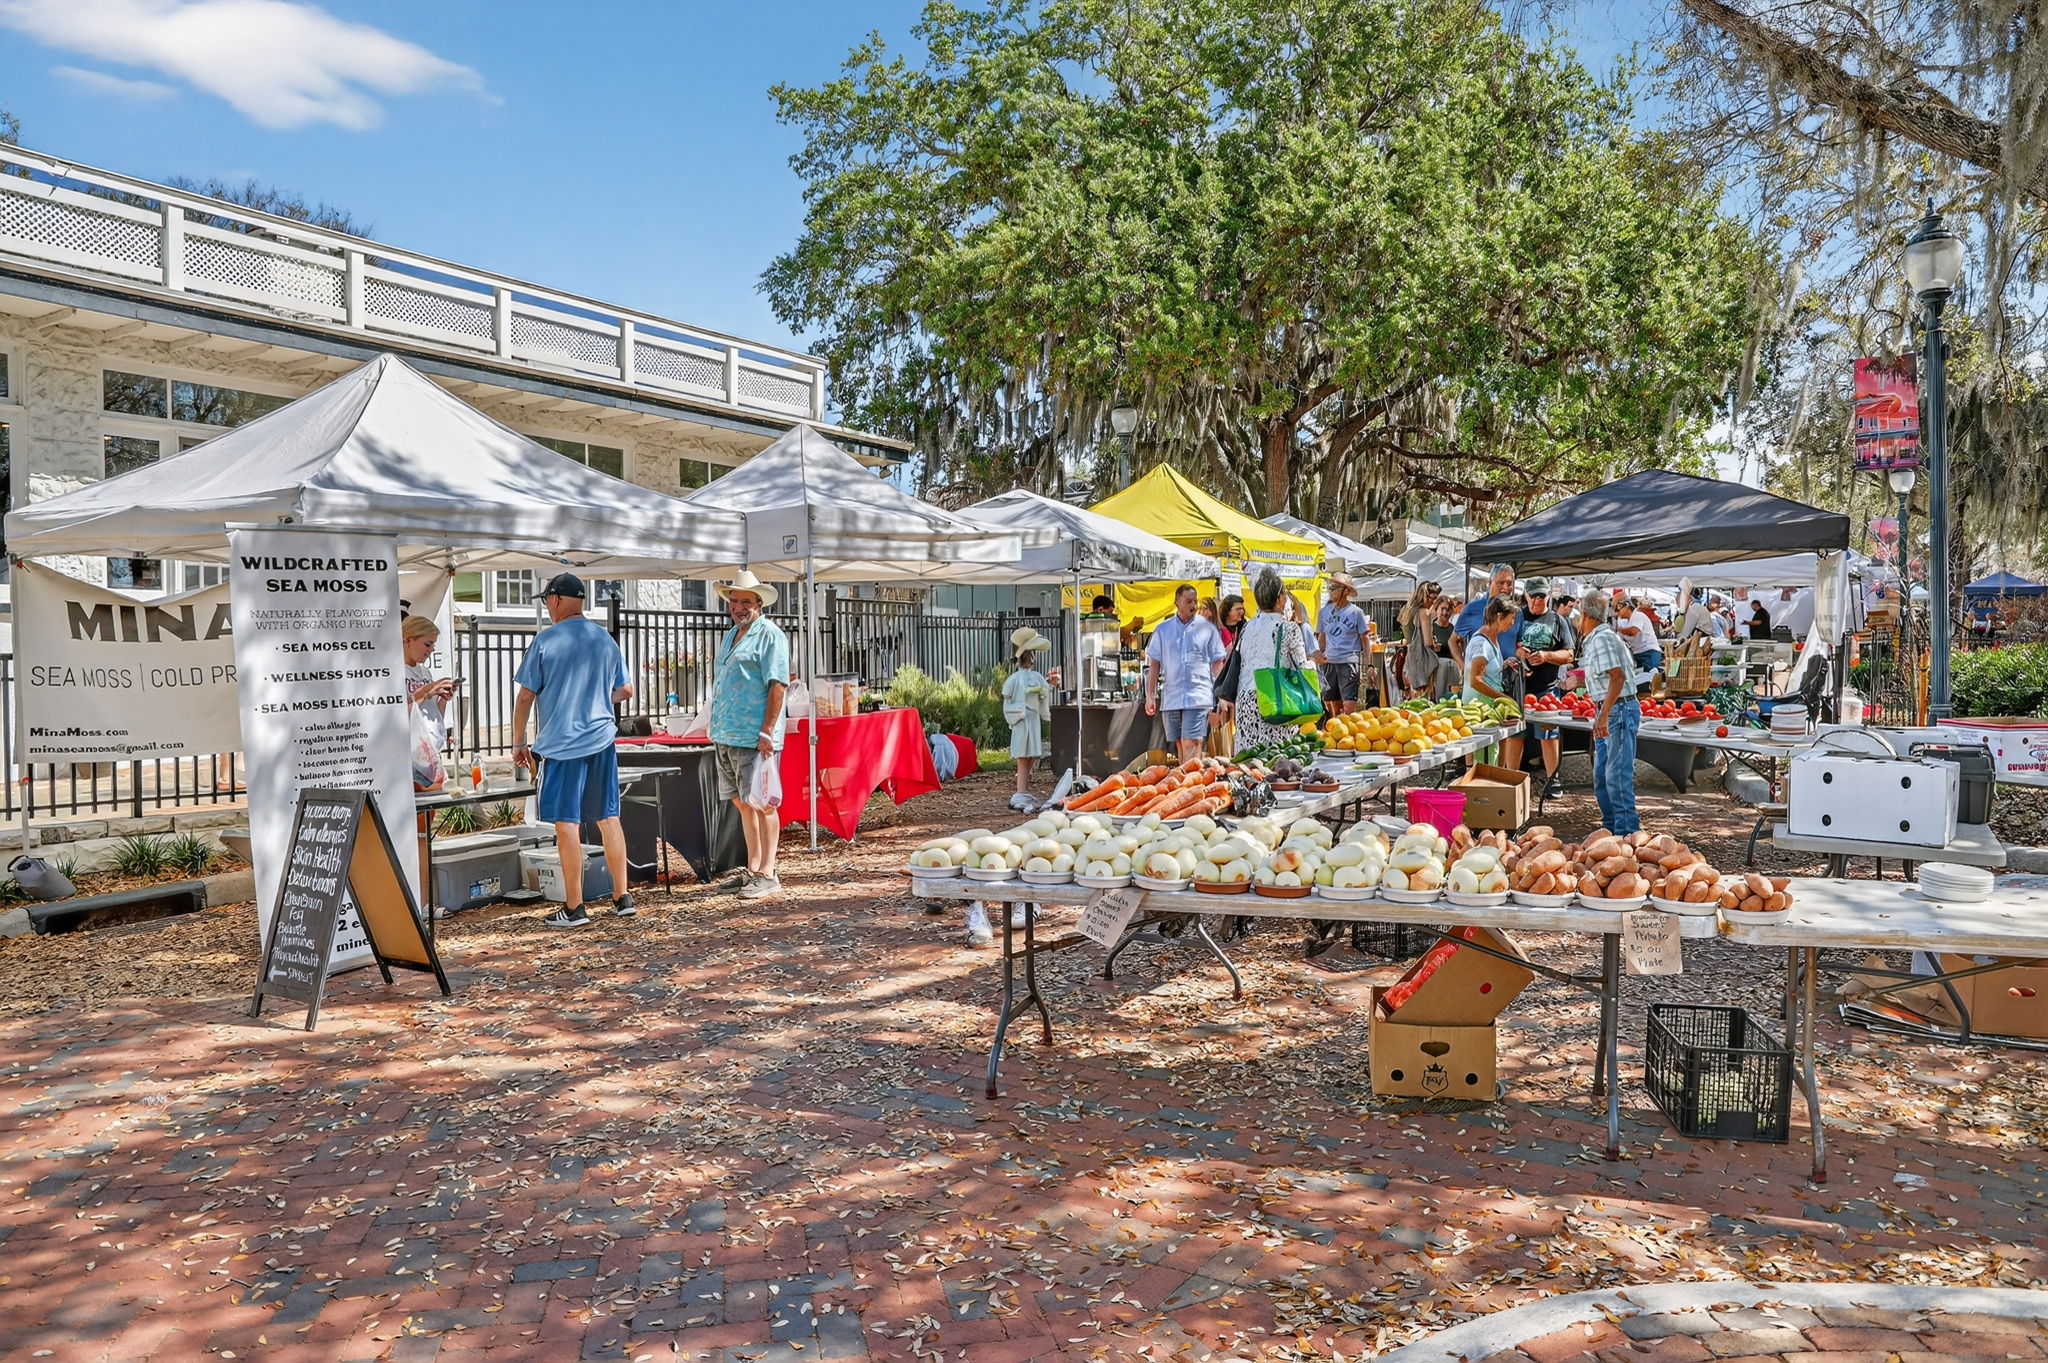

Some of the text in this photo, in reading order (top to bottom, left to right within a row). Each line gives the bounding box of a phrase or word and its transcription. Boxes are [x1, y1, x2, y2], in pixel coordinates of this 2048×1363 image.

[240, 556, 388, 572] WILDCRAFTED
[266, 578, 368, 593] SEA MOSS
[64, 600, 233, 643] MINA
[250, 608, 387, 619] NATURALLY FLAVORED
[255, 619, 383, 631] WITH ORGANIC FRUIT
[282, 643, 309, 653] SEA
[312, 641, 348, 652] MOSS
[31, 665, 76, 687] SEA
[82, 667, 132, 689] MOSS
[151, 666, 203, 688] COLD
[271, 667, 390, 683] WELLNESS SHOTS
[261, 695, 403, 714] SEA MOSS LEMONADE
